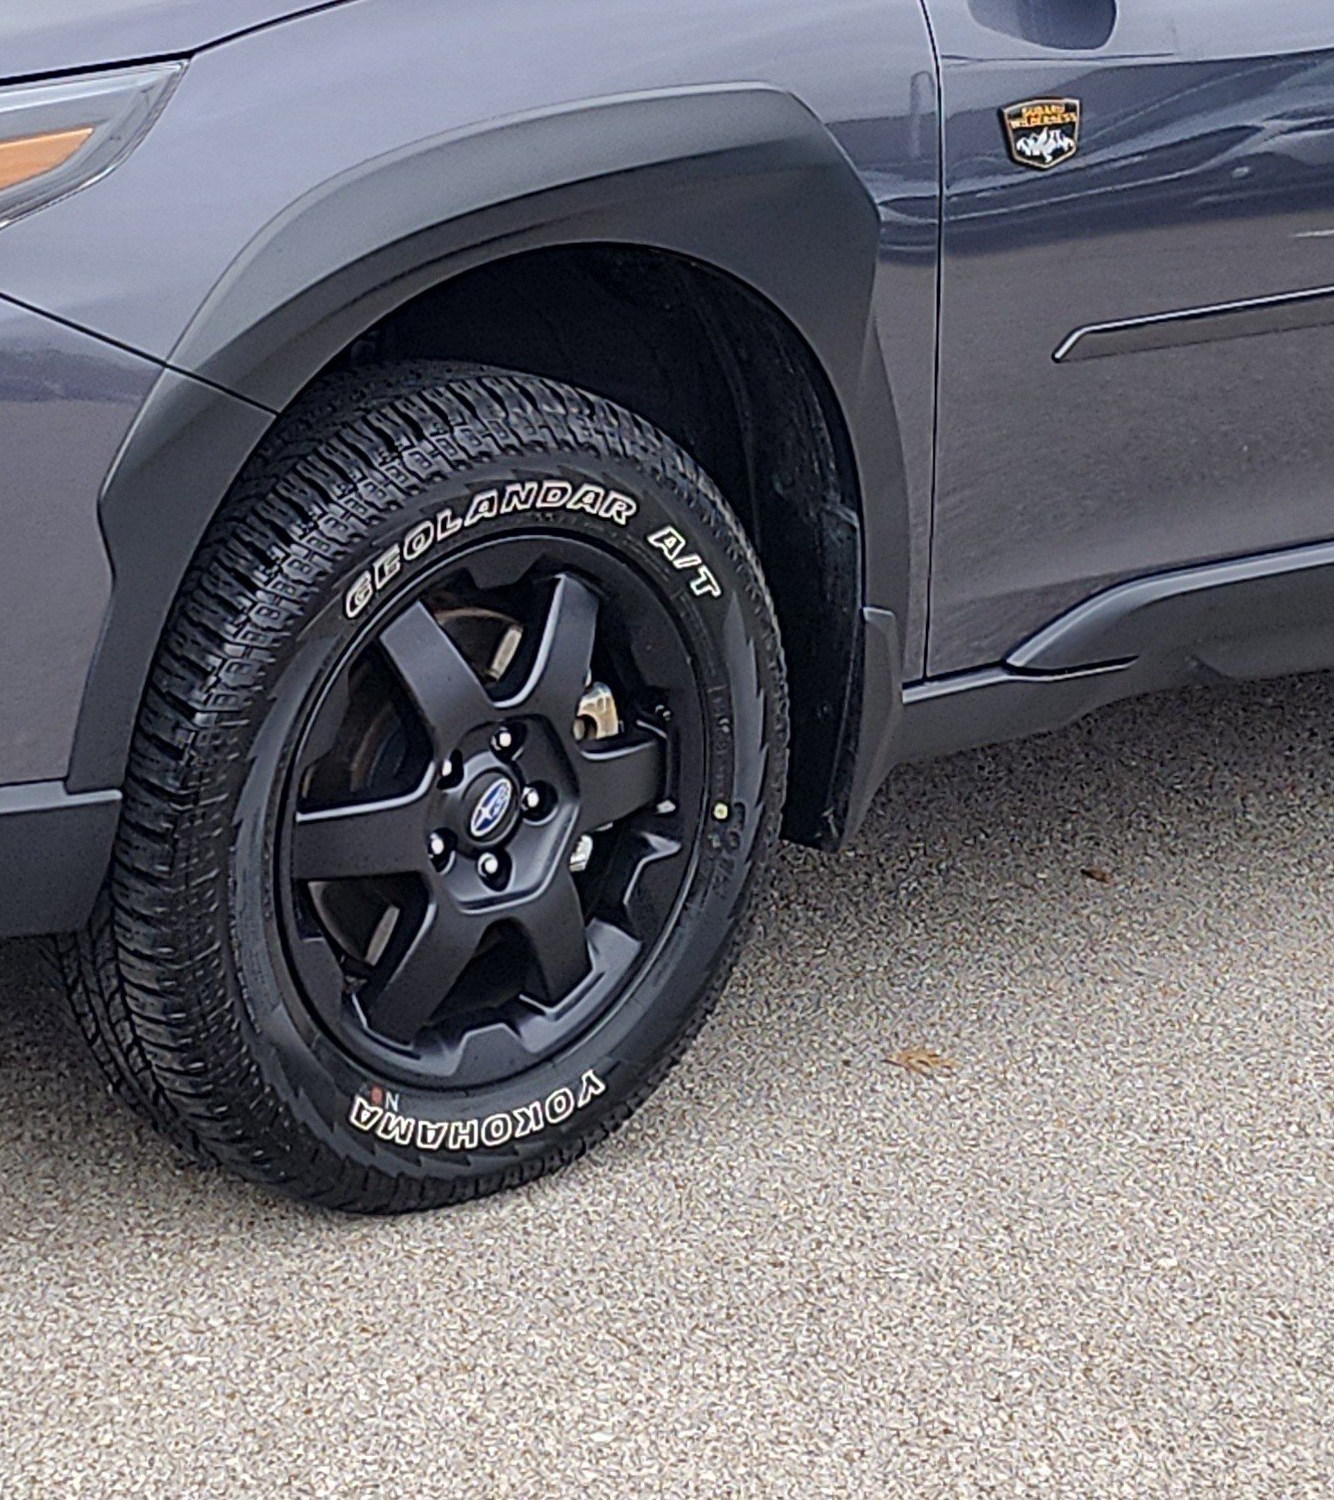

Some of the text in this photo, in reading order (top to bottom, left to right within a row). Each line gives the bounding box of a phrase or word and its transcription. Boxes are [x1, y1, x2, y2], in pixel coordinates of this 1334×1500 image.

[344, 480, 723, 618] GEOLANDAR A/T
[349, 1068, 607, 1150] YOKOHAMA
